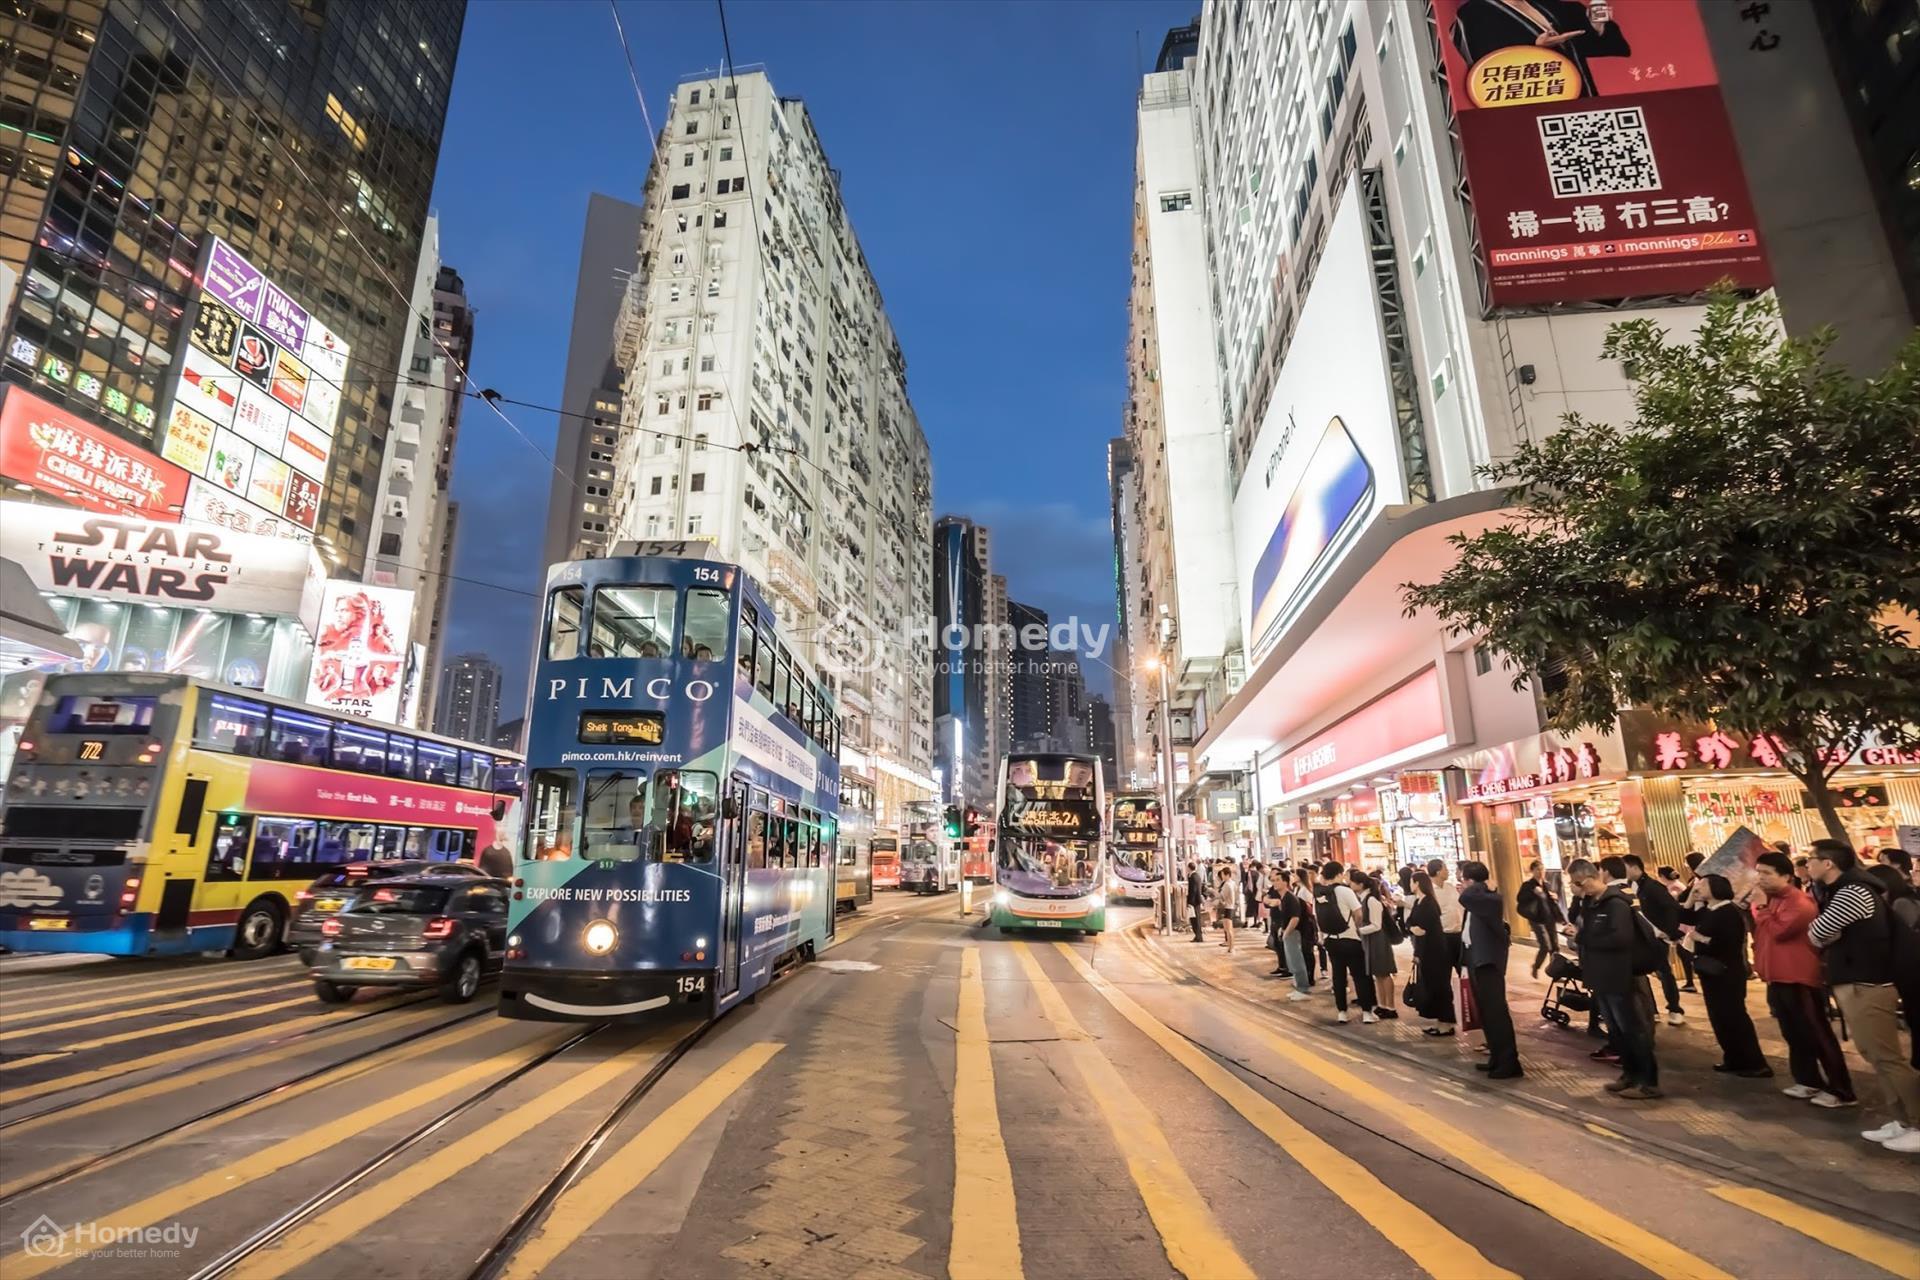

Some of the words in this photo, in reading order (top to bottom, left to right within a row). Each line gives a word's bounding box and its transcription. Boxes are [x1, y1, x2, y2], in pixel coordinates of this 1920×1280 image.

[1741, 2, 1781, 51] 中心
[1482, 61, 1563, 84] 只有萬寧
[1485, 79, 1565, 101] 才是正貨
[1508, 204, 1605, 239] 掃一掃
[1616, 196, 1730, 230] 冇三高?
[1495, 246, 1569, 264] mannings
[1625, 237, 1699, 254] mannings
[53, 518, 233, 563] STAR
[633, 540, 687, 556] 154
[37, 542, 83, 556] THE
[107, 551, 168, 566] LAST
[188, 562, 242, 575] JEDI
[49, 555, 229, 601] WARS
[562, 567, 583, 581] 154
[693, 567, 720, 582] 154
[548, 677, 716, 701] PIMCO
[331, 697, 373, 708] STAR
[586, 722, 608, 732] Shek
[612, 722, 633, 733] Tong
[561, 750, 682, 763] pimco.com.hk/reinvent
[1062, 811, 1079, 826] 2A
[526, 887, 572, 901] EXPLORE
[575, 888, 602, 901] NEW
[605, 888, 691, 902] POSSIBILITIES
[676, 977, 706, 993] 154
